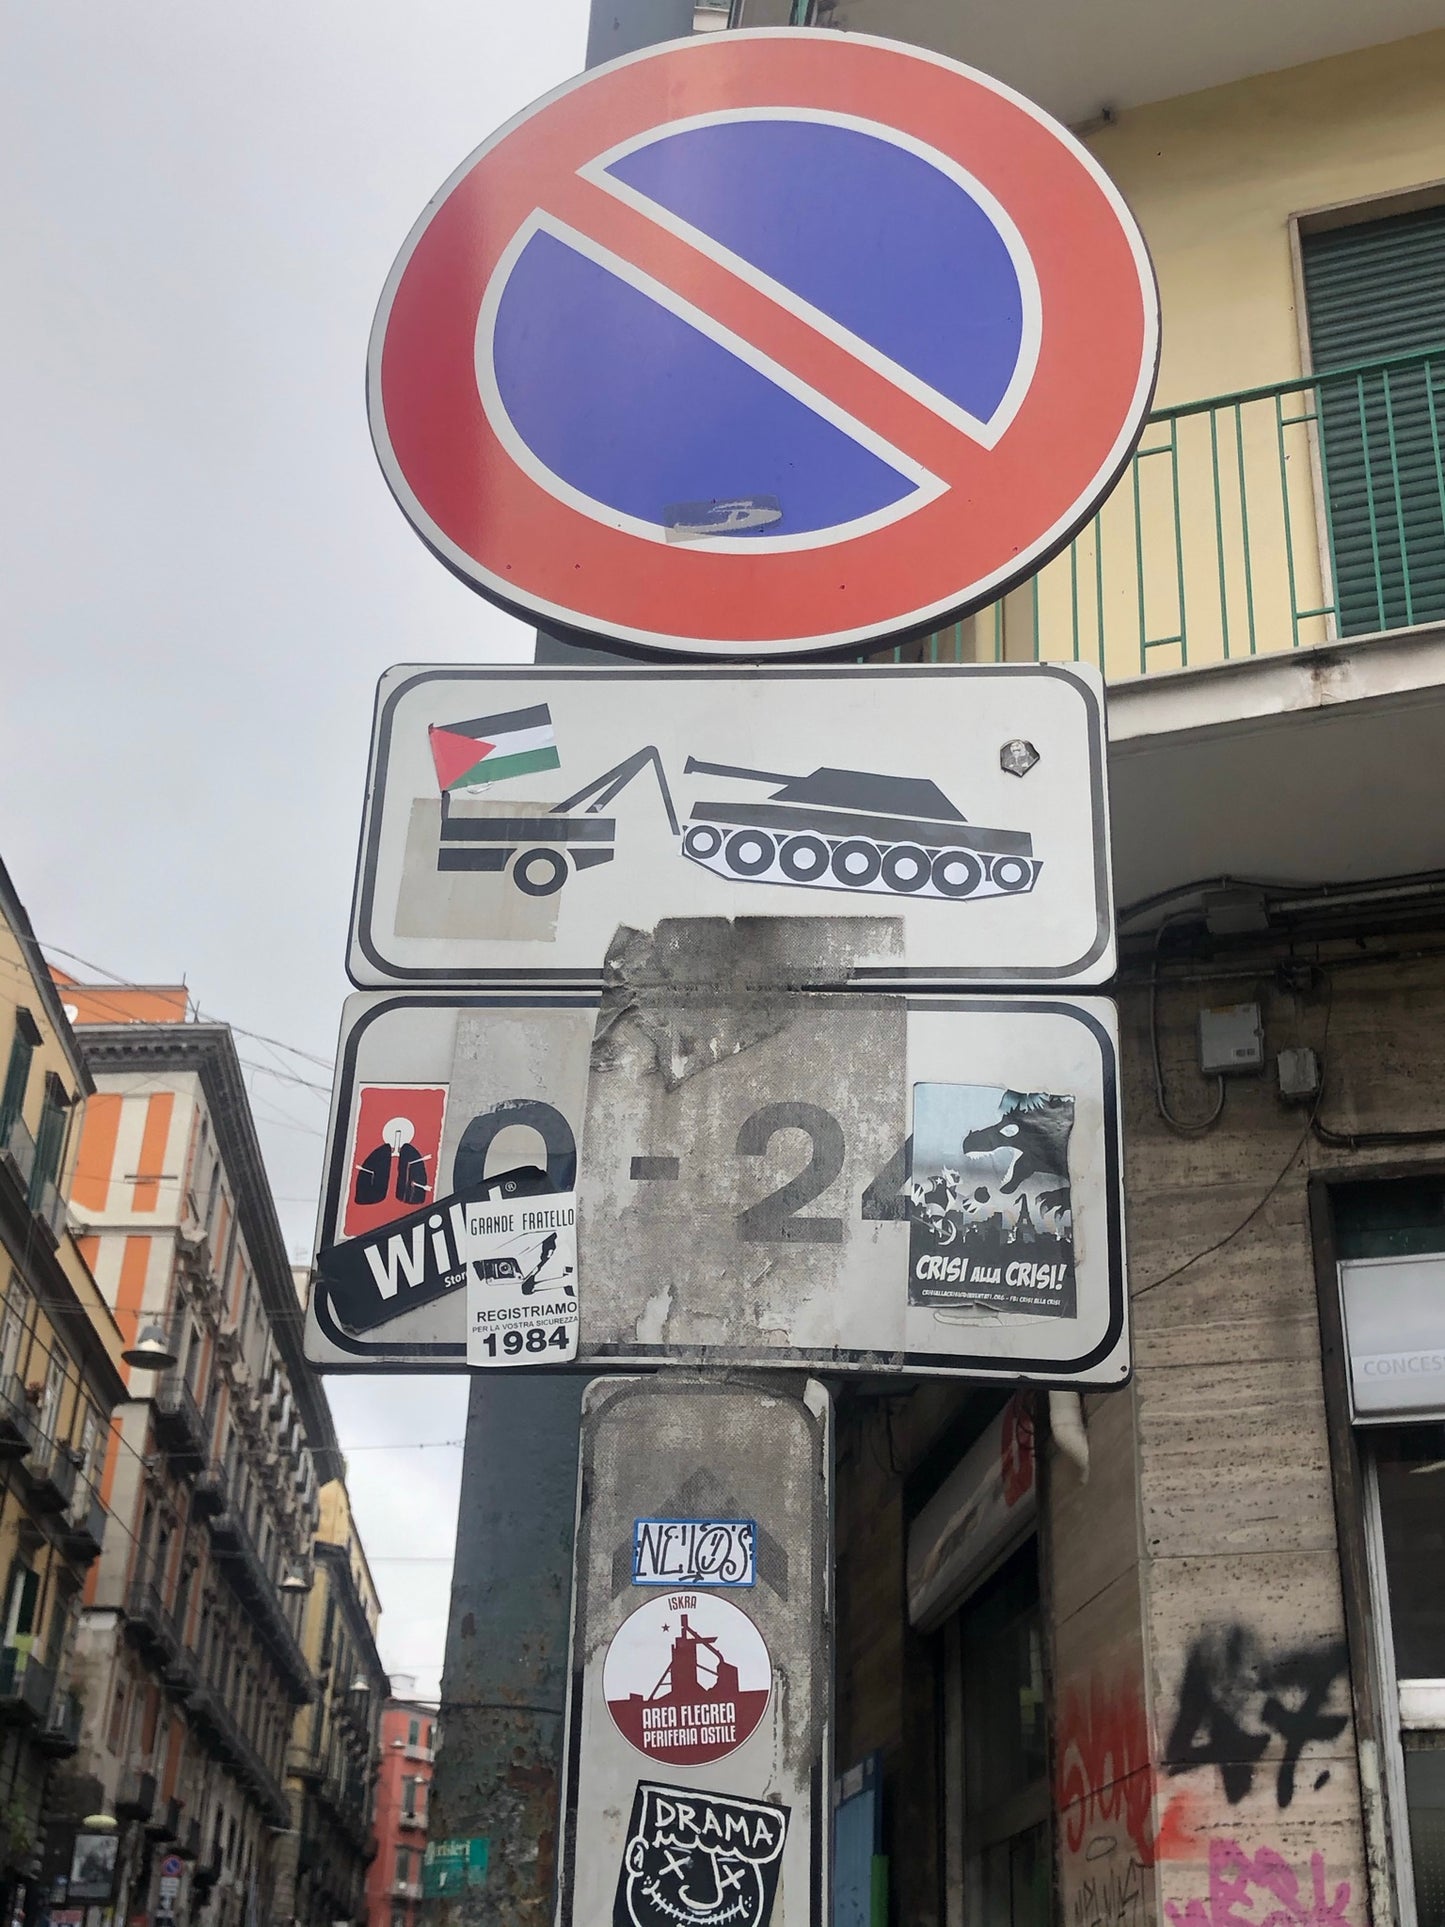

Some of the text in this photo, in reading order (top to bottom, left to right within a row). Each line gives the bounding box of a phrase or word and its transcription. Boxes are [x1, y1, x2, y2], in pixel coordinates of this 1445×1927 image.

[470, 1208, 575, 1236] GRANDE FRATELLO
[363, 1185, 503, 1300] Wil
[444, 1271, 467, 1288] Stor
[915, 1254, 1068, 1291] CRISI ALLA CRISI!
[472, 1315, 579, 1333] PER LA VOSTRA SICUREZZA
[476, 1301, 578, 1323] REGISTRIAMO
[482, 1325, 570, 1358] 1984
[667, 1595, 698, 1612] ISKRA
[642, 1702, 736, 1729] AREA FLEGREA
[643, 1725, 737, 1749] PERIFERIA OSTILE
[655, 1798, 774, 1848] DRAMA
